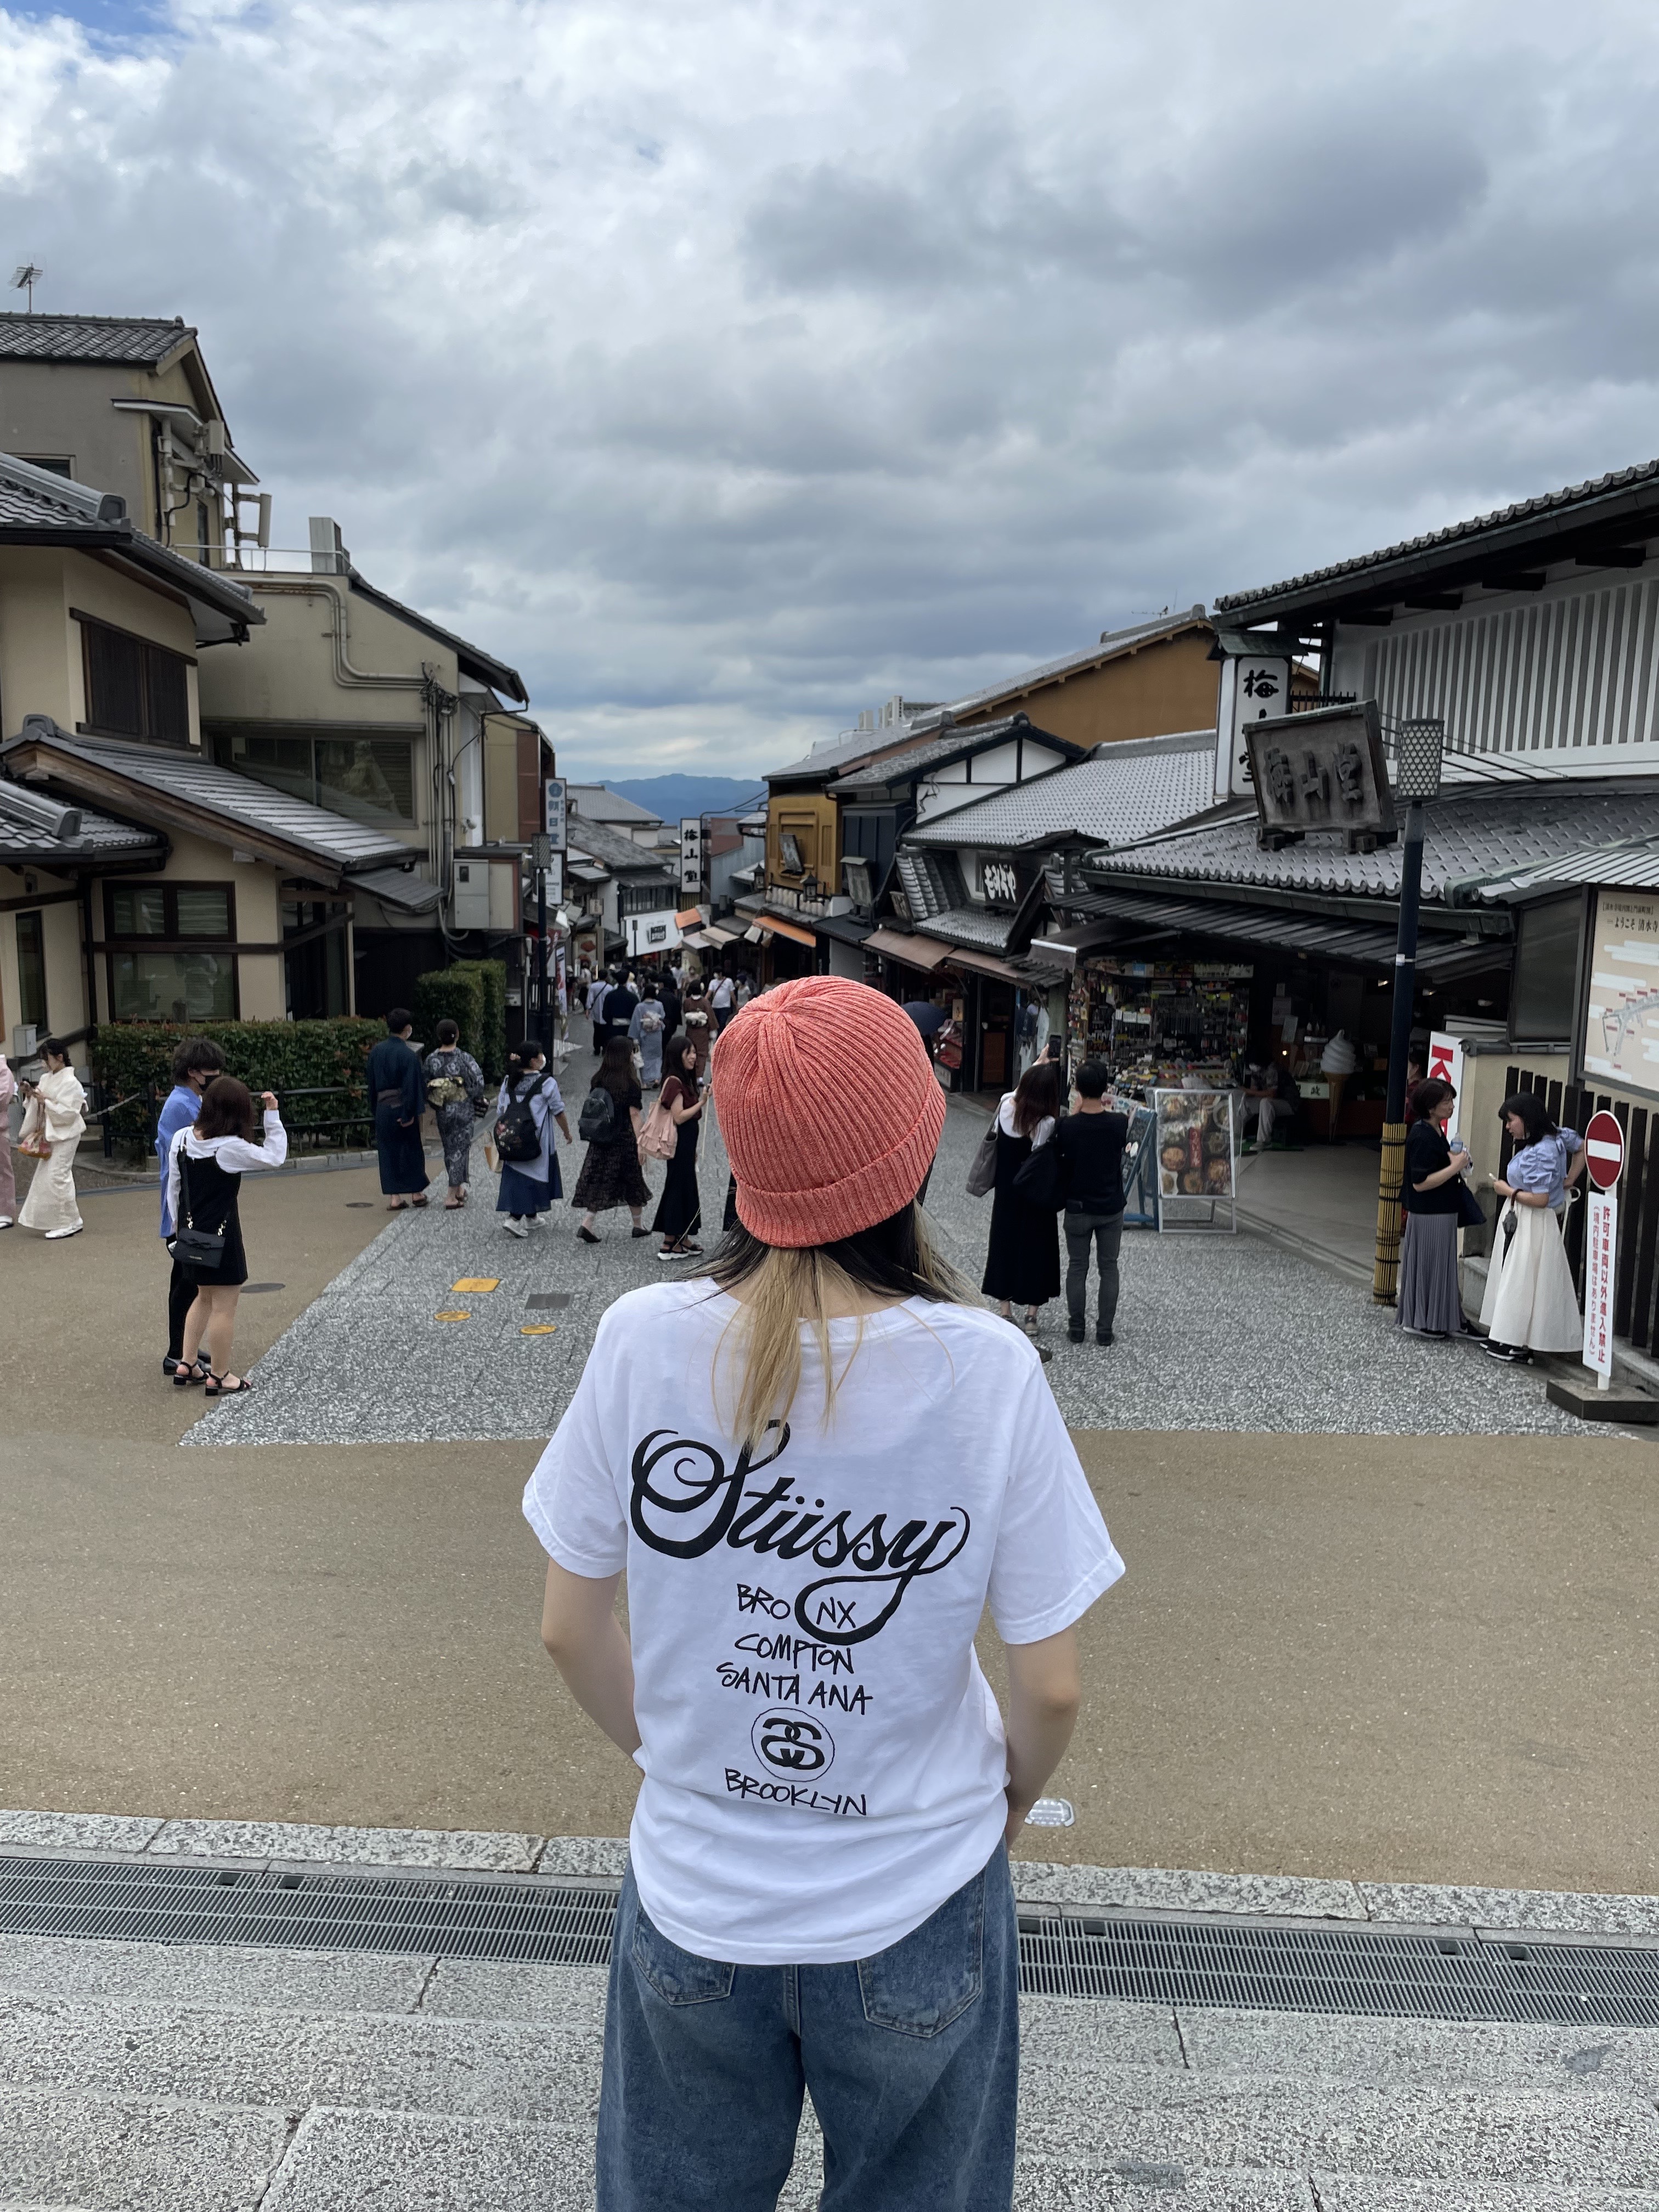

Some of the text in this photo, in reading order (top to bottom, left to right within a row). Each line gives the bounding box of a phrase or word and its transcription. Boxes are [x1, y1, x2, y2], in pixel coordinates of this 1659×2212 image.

[1598, 1205, 1611, 1363] 許可車両以外進入禁止
[631, 1419, 970, 1645] Stüssy
[734, 1633, 854, 1674] COMPTON
[716, 1662, 873, 1715] SANTA ANA
[725, 1768, 867, 1816] BROOKLYN
